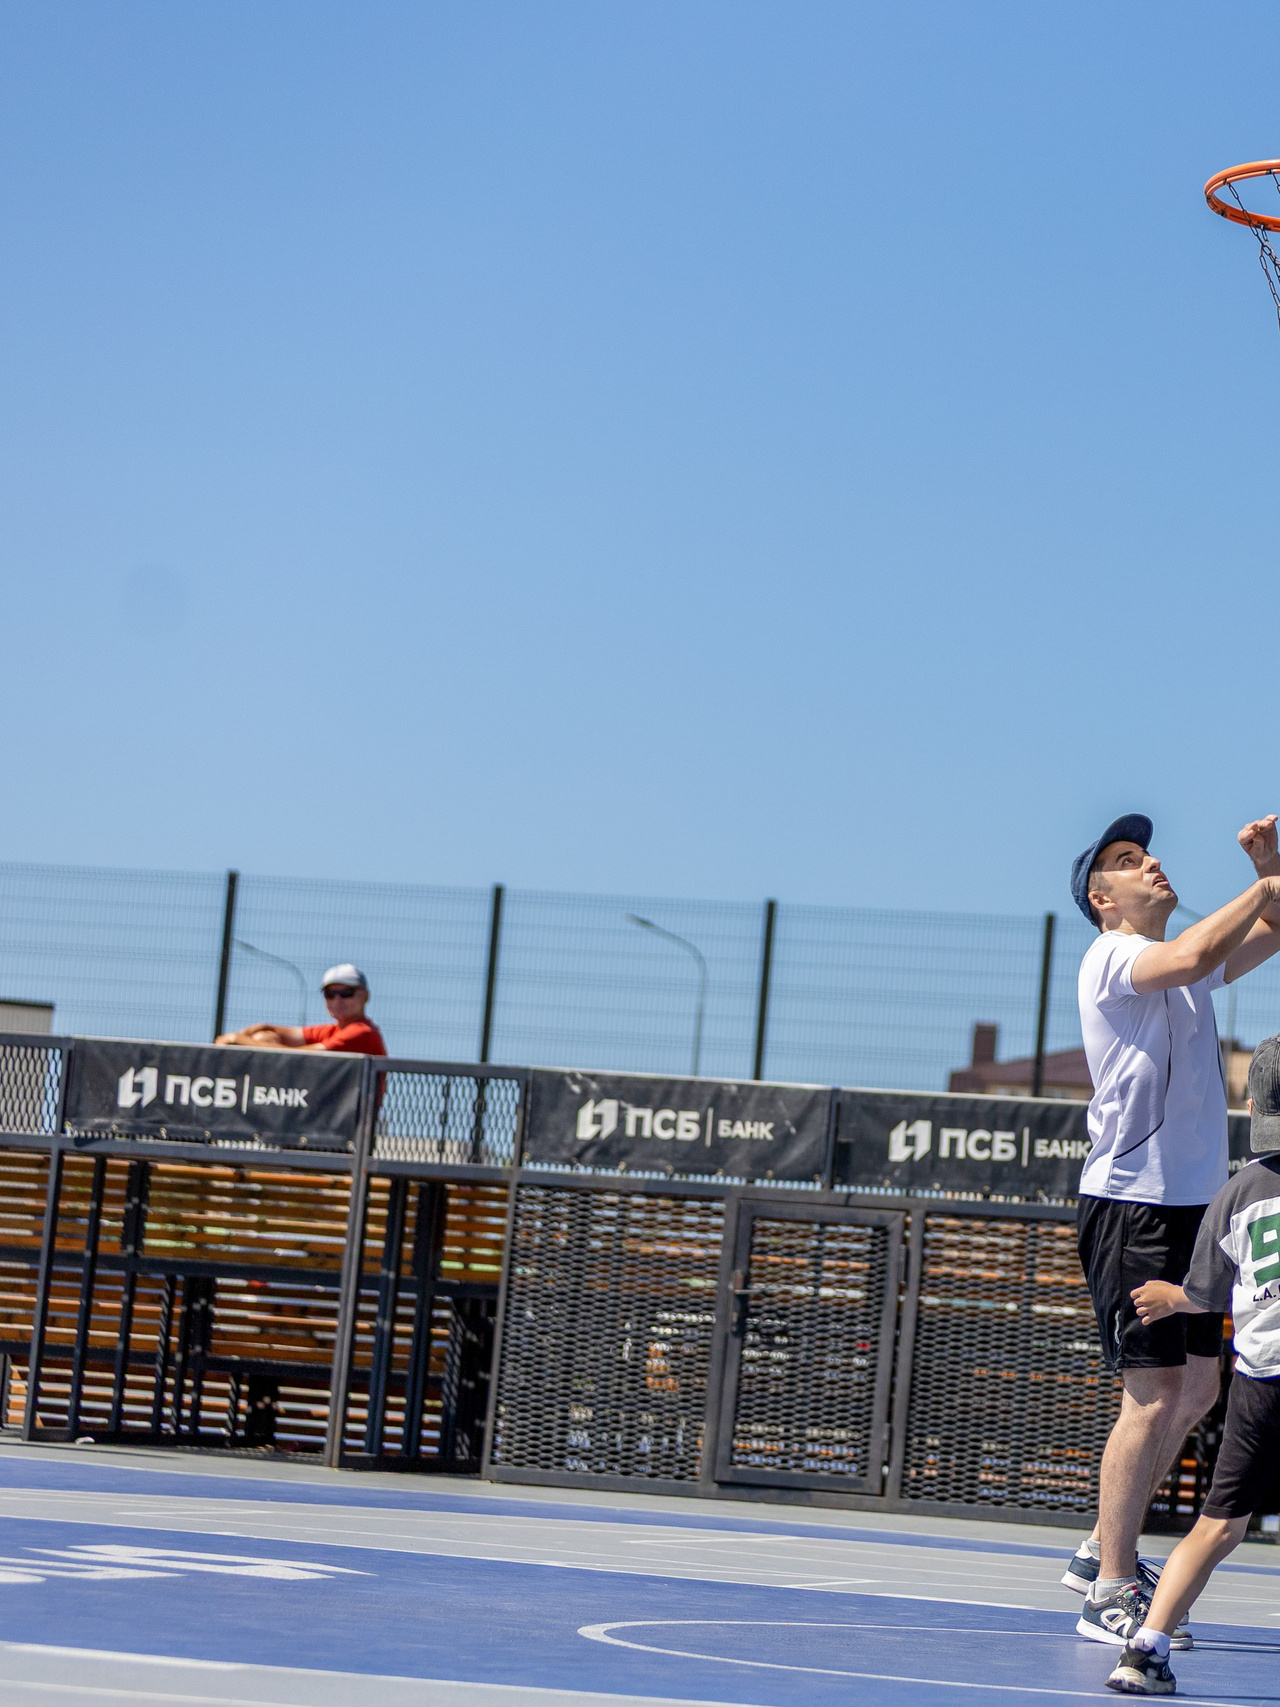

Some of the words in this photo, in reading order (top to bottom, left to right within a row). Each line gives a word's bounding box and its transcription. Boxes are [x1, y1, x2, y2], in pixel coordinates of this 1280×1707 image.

[165, 1074, 237, 1109] ПСБ
[253, 1085, 309, 1108] БАНК
[625, 1108, 700, 1141] ПСБ
[718, 1119, 774, 1141] БАНК
[939, 1127, 1017, 1162] ПСБ
[1035, 1138, 1091, 1161] БАНК
